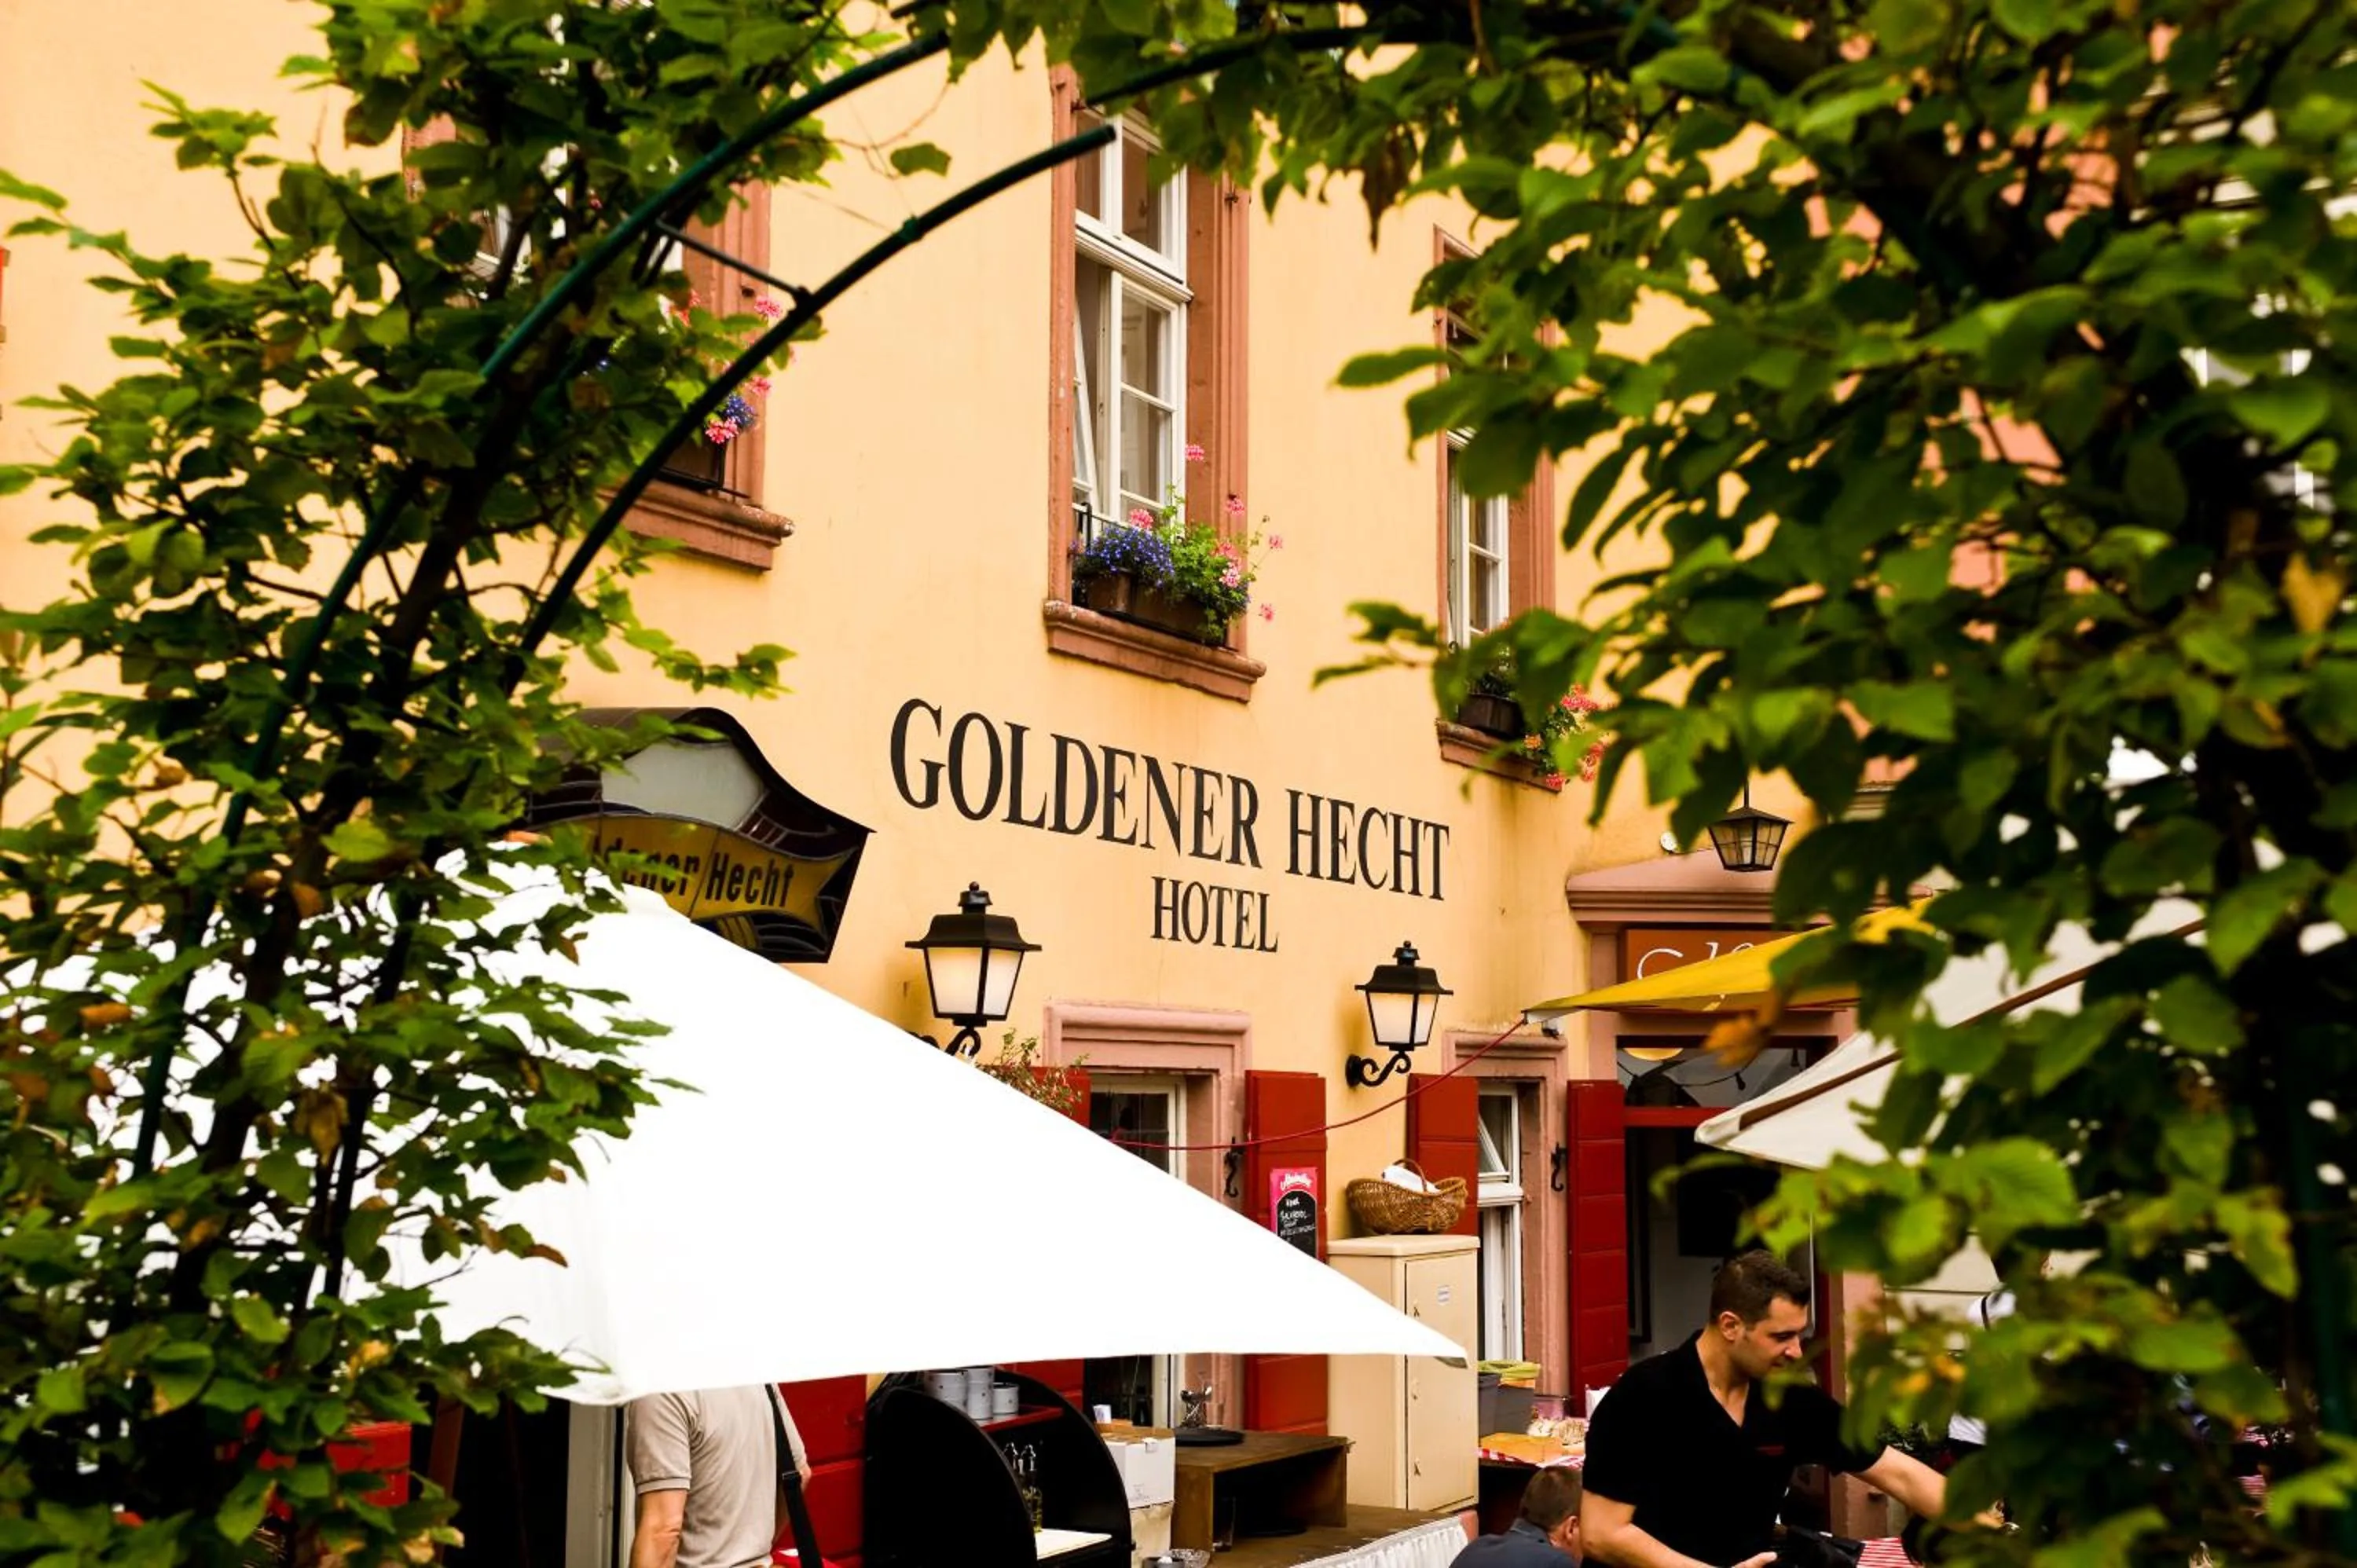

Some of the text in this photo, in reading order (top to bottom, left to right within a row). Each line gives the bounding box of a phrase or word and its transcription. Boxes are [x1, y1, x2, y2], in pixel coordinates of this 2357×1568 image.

[890, 698, 1450, 901] GOLDENER HECHT
[705, 852, 794, 907] Hecht
[1151, 876, 1278, 953] HOTEL
